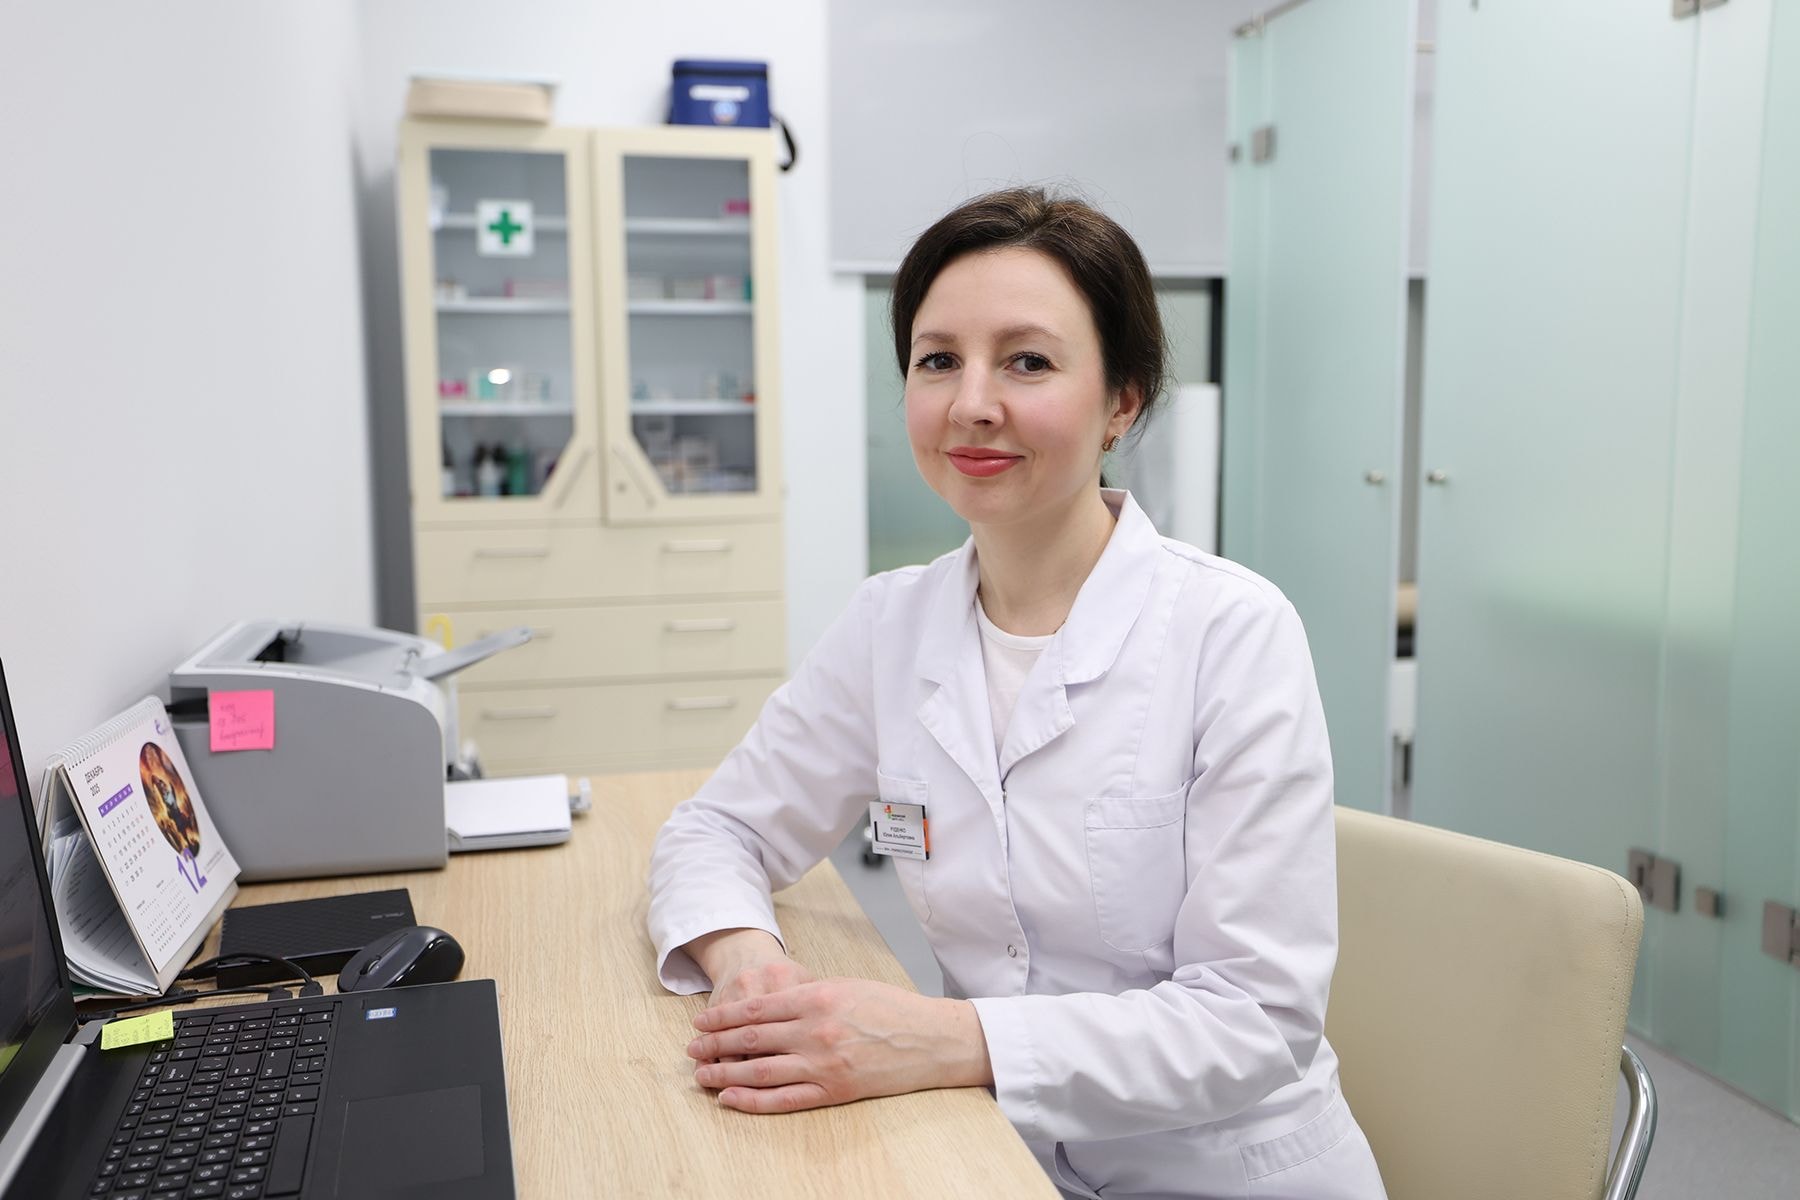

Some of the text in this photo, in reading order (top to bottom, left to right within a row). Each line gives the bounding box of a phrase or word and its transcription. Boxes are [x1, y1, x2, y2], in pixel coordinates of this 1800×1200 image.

[85, 765, 104, 784] ДЕКАБРЬ
[90, 783, 101, 797] 2025
[176, 848, 207, 894] 12
